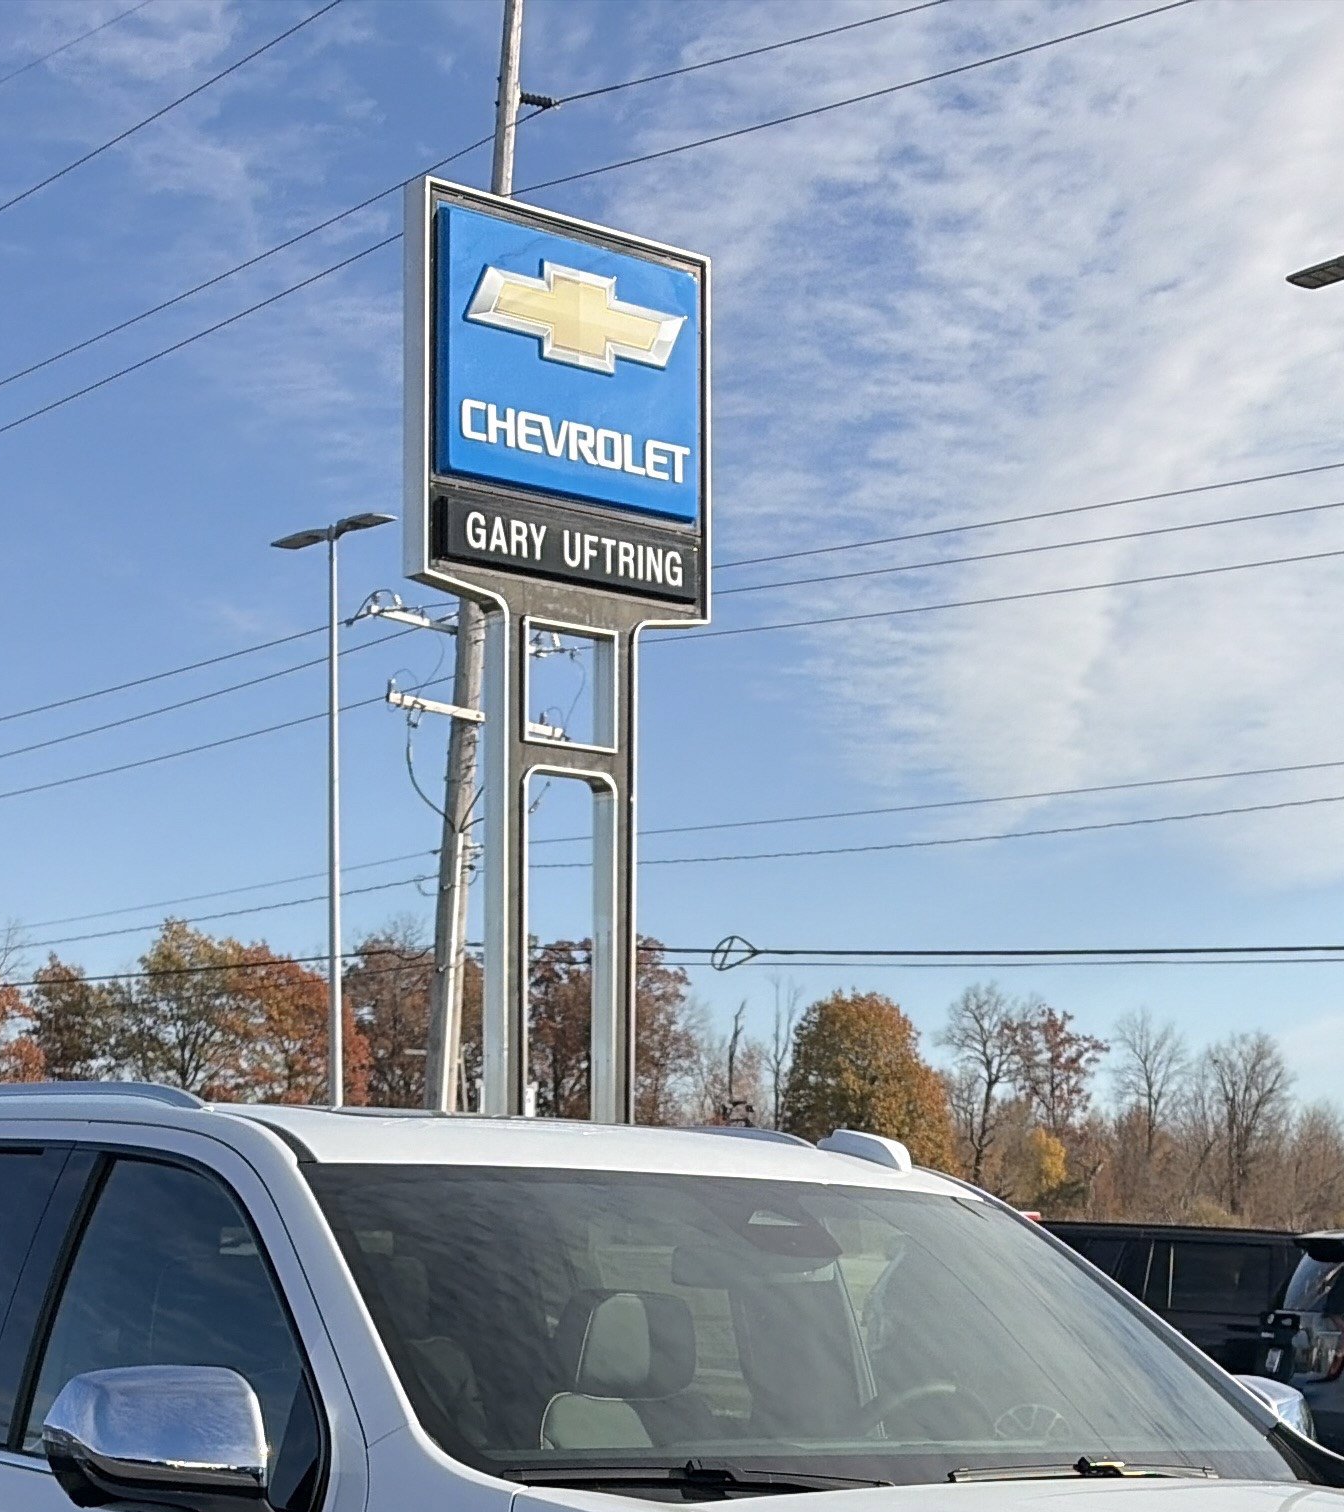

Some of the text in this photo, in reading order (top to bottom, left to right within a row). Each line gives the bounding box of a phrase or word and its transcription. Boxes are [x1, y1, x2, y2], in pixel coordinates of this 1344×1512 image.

[461, 398, 690, 484] CHEVROLET
[466, 511, 683, 587] GARY UFTRING
